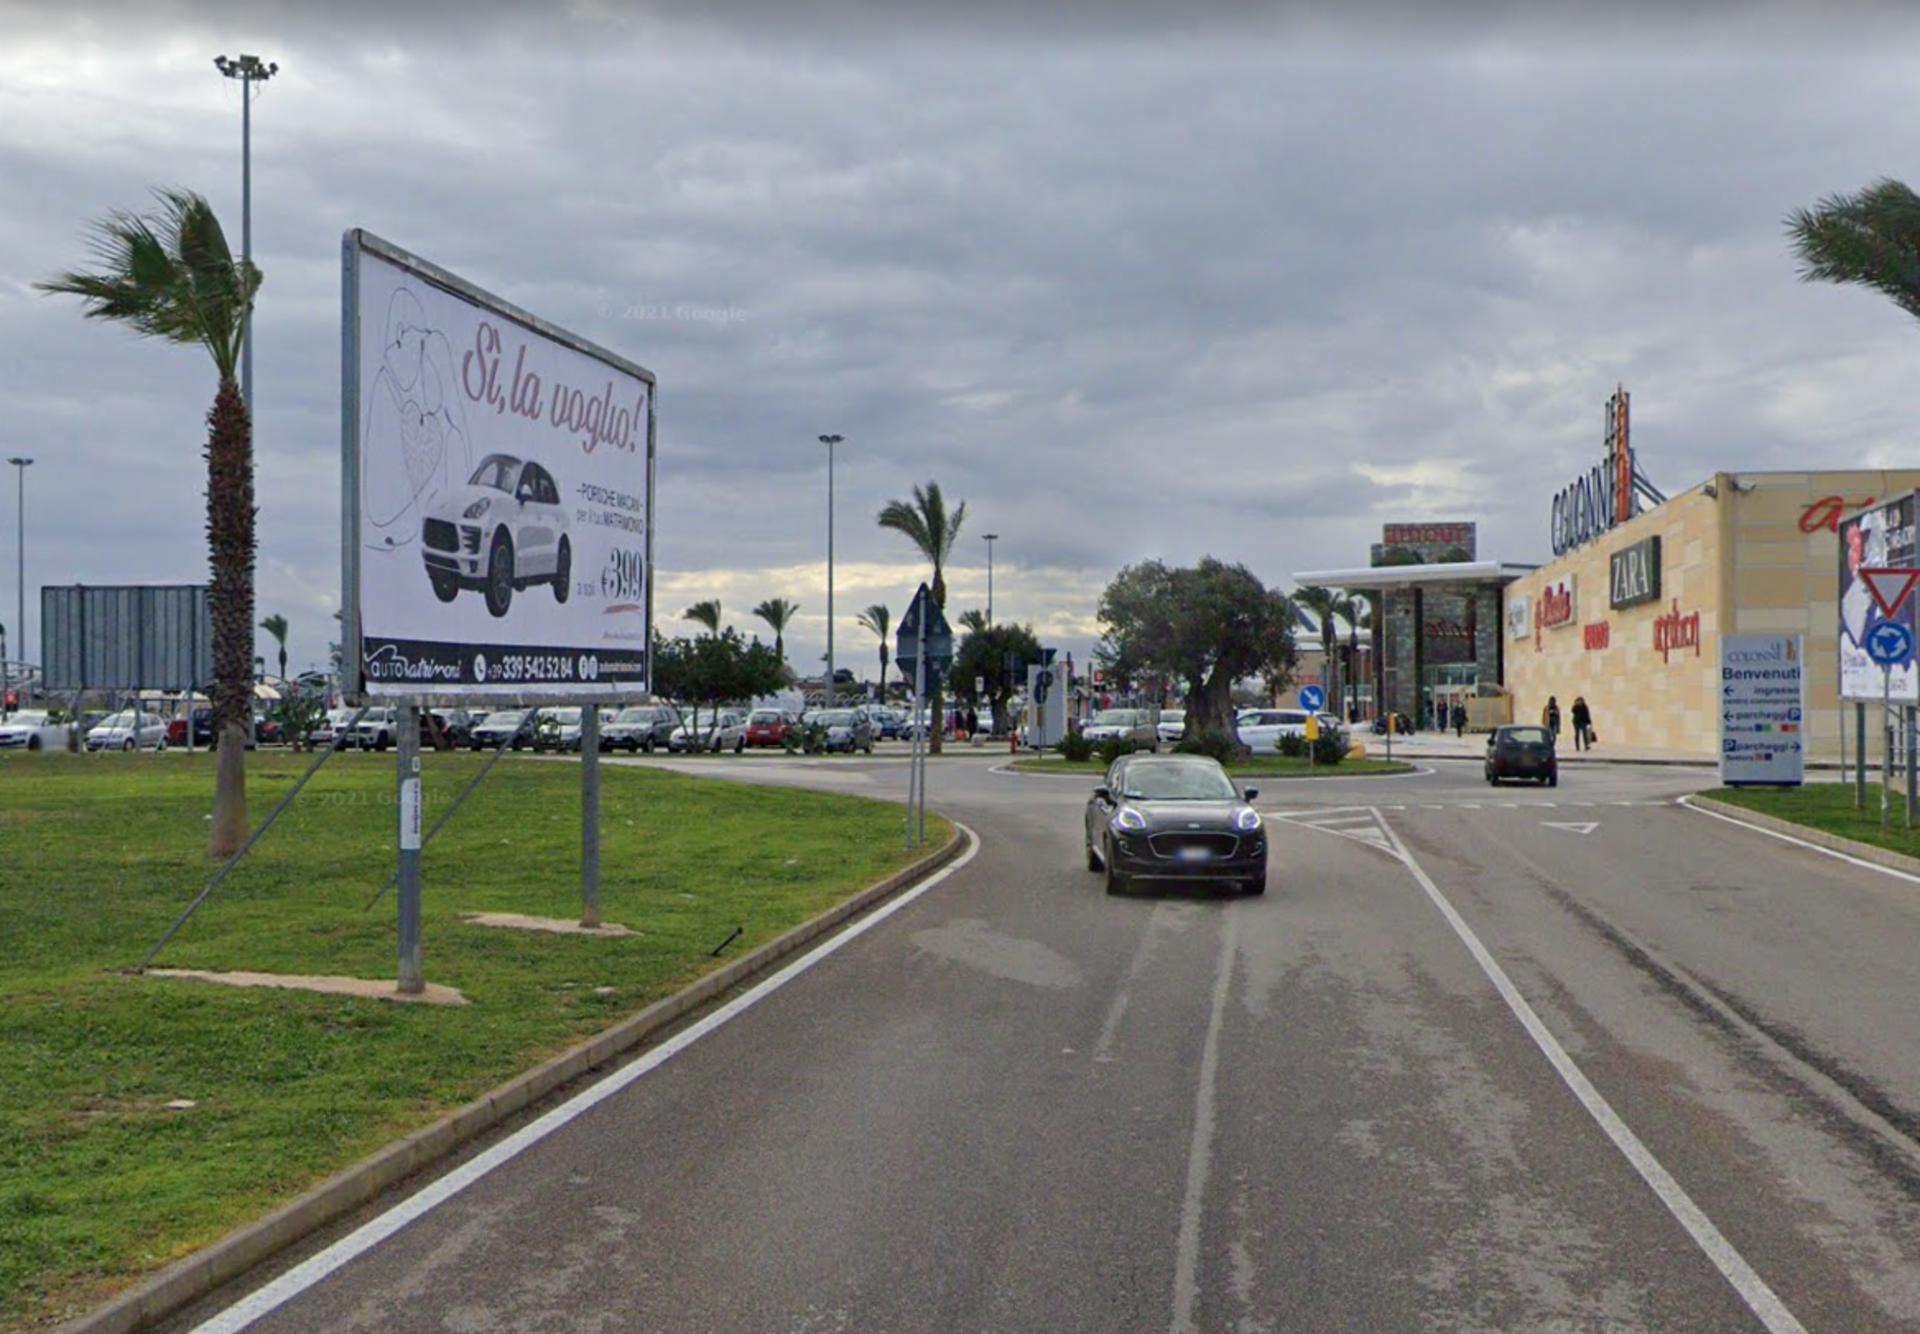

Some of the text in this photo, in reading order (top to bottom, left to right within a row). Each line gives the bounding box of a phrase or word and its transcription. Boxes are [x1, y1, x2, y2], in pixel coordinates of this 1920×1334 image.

[550, 381, 644, 454] voglio!
[1612, 549, 1649, 603] ZARA
[1722, 665, 1801, 680] Benvenuti
